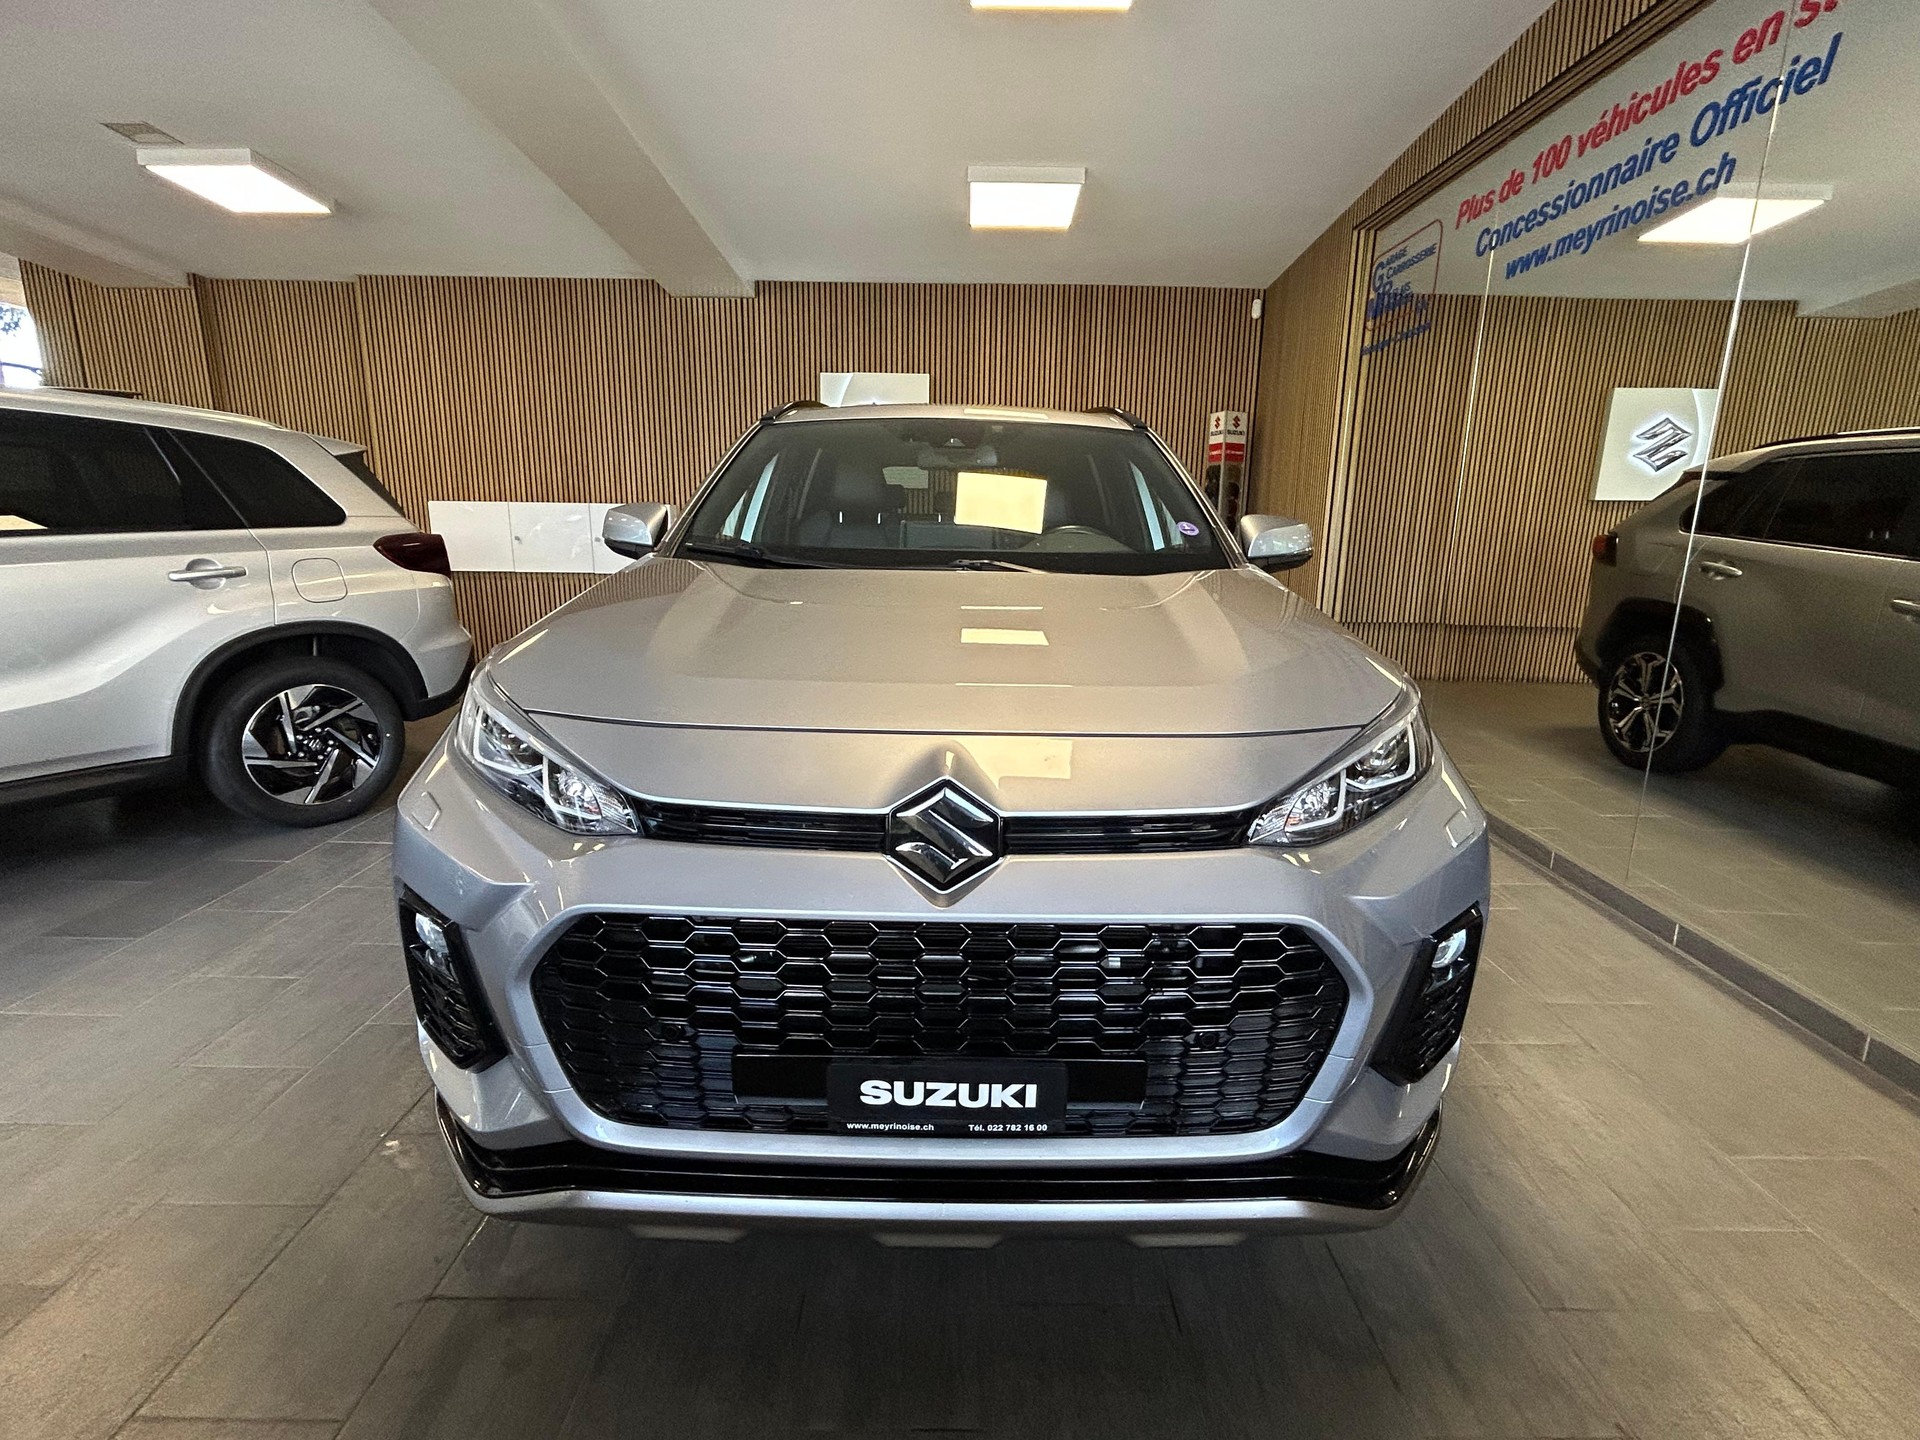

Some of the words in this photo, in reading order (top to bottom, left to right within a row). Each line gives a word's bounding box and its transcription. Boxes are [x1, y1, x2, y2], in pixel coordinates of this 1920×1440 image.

[1455, 189, 1496, 230] Plus
[1498, 168, 1525, 203] de
[1532, 134, 1572, 184] 100
[1576, 49, 1724, 158] véhicules
[1732, 10, 1785, 65] en
[1793, 0, 1839, 28] s
[1475, 132, 1680, 257] Concessionnaire
[1690, 31, 1844, 147] Officiel
[1504, 152, 1737, 280] www.meyrinoise.ch
[846, 1122, 935, 1131] www.meyrinoise.ch
[859, 1079, 1038, 1109] SUZUKI
[987, 1124, 1004, 1132] 022
[1005, 1124, 1022, 1132] 782
[1024, 1124, 1035, 1132] 16
[1036, 1124, 1048, 1132] 00
